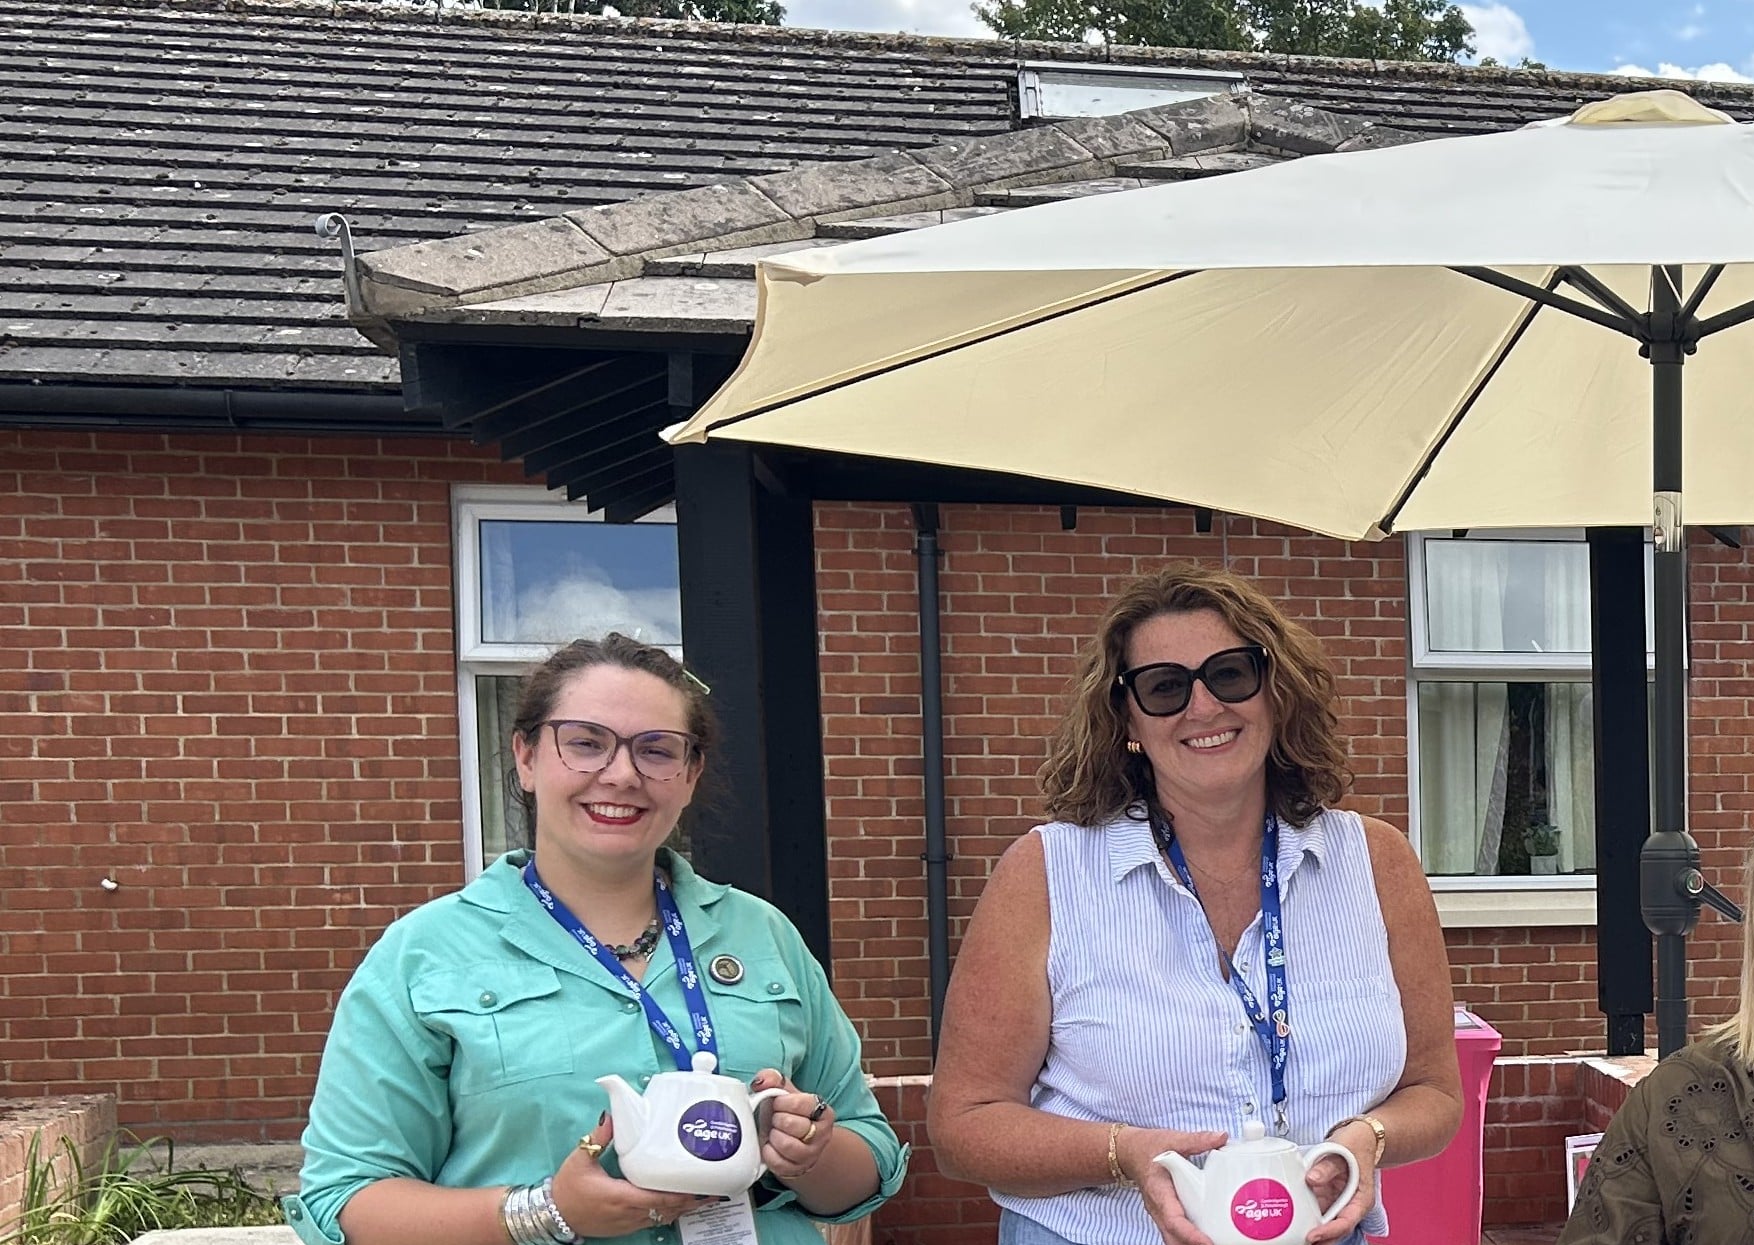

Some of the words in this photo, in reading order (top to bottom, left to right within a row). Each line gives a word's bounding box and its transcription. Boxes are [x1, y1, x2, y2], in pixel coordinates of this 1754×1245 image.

[693, 1128, 718, 1141] age
[1245, 1208, 1269, 1221] age
[1269, 1208, 1283, 1218] UK
